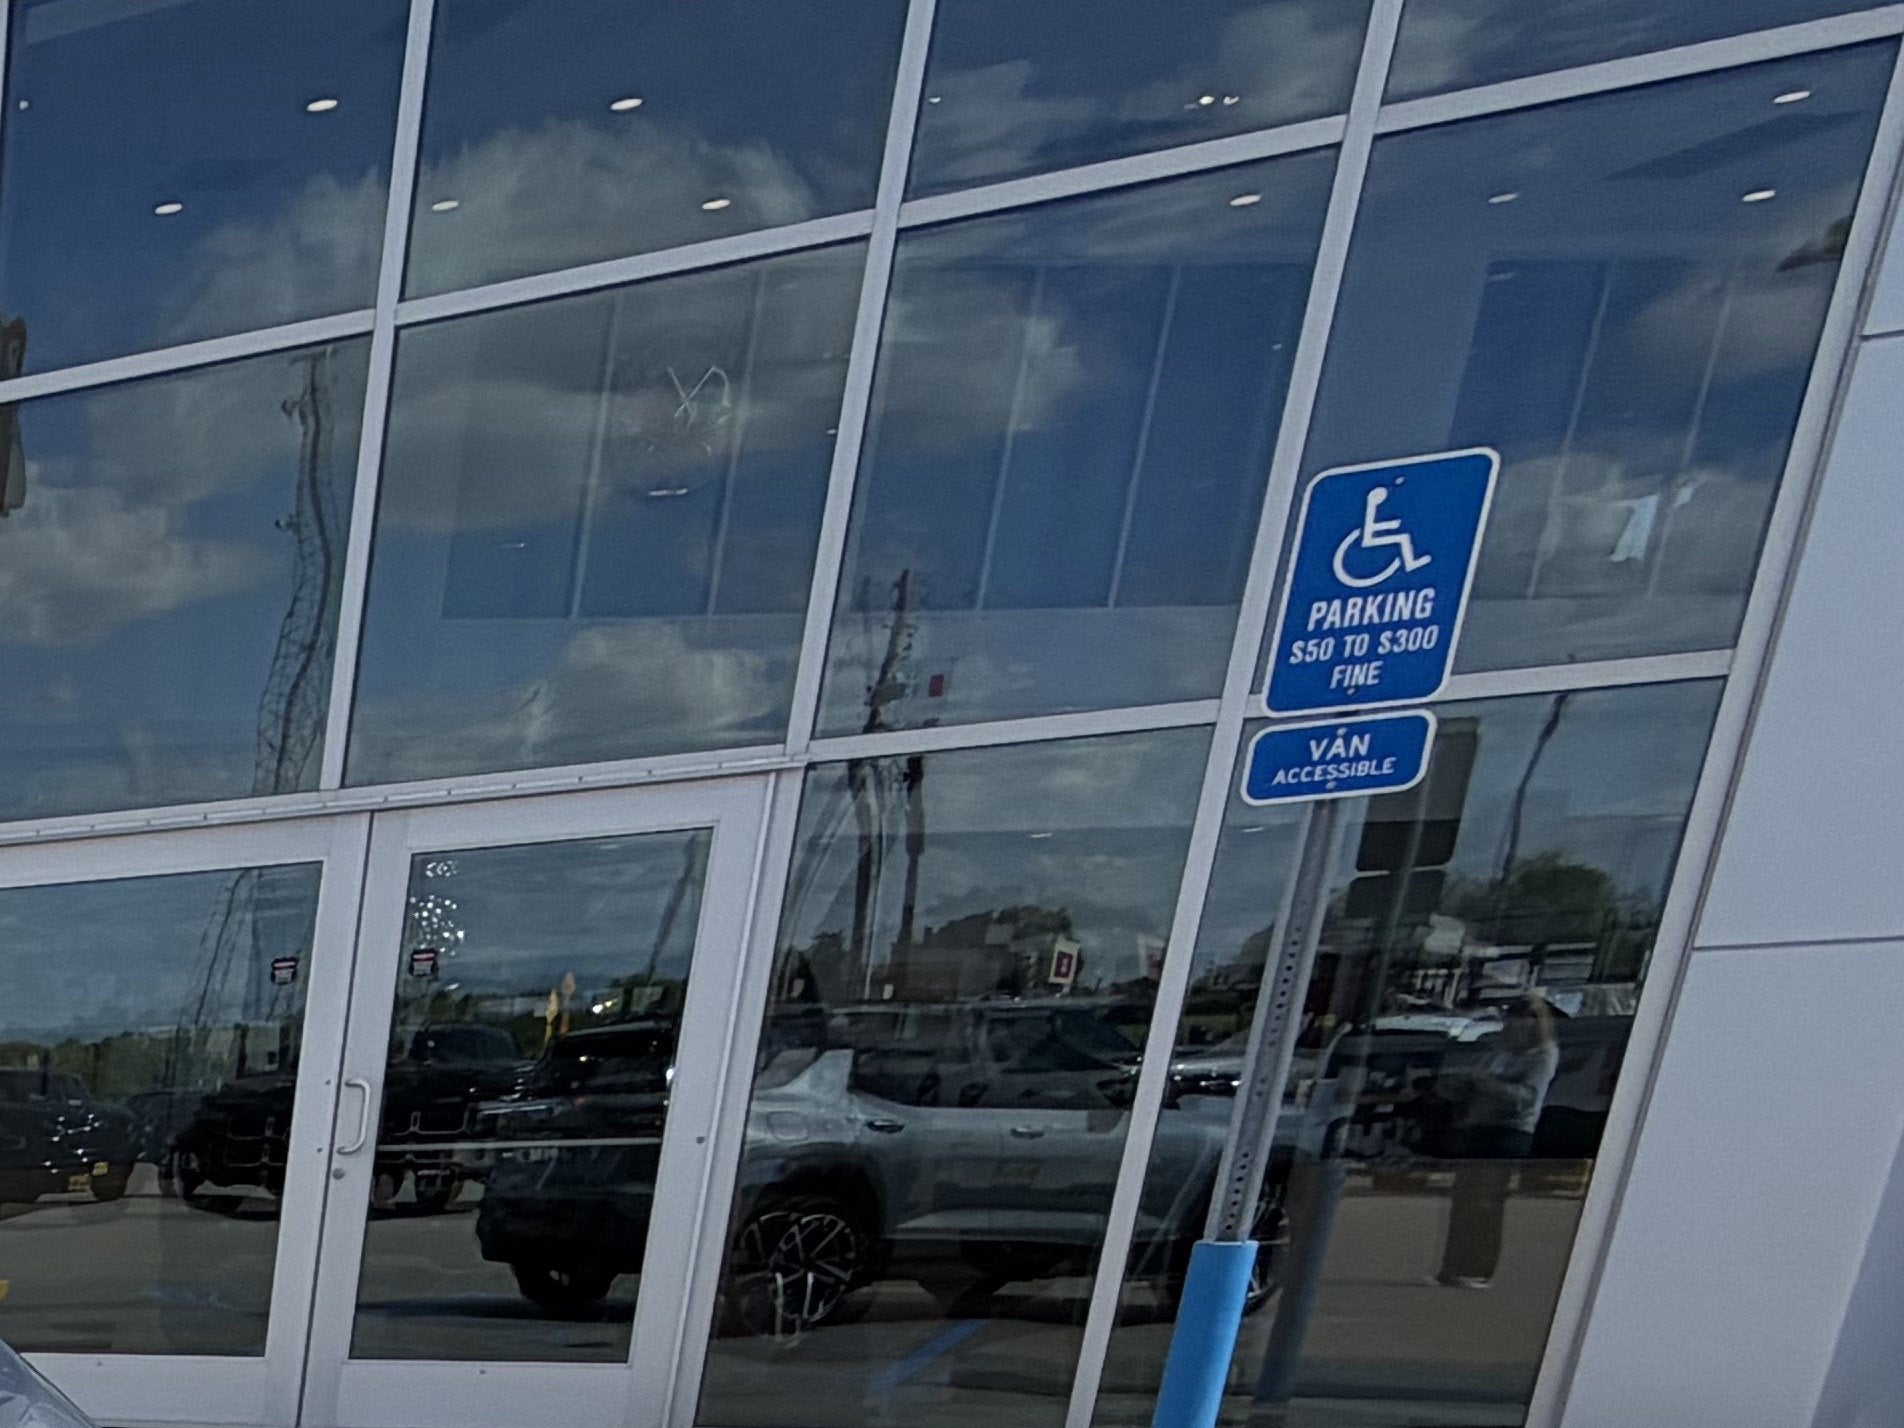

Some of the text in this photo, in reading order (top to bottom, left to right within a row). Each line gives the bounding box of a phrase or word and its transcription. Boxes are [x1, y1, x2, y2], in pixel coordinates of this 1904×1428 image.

[1307, 587, 1436, 632] PARKING
[1343, 633, 1370, 658] TO
[1330, 661, 1384, 690] FINE
[1309, 733, 1372, 761] VAN
[1271, 757, 1396, 786] ACCESSIBLE
